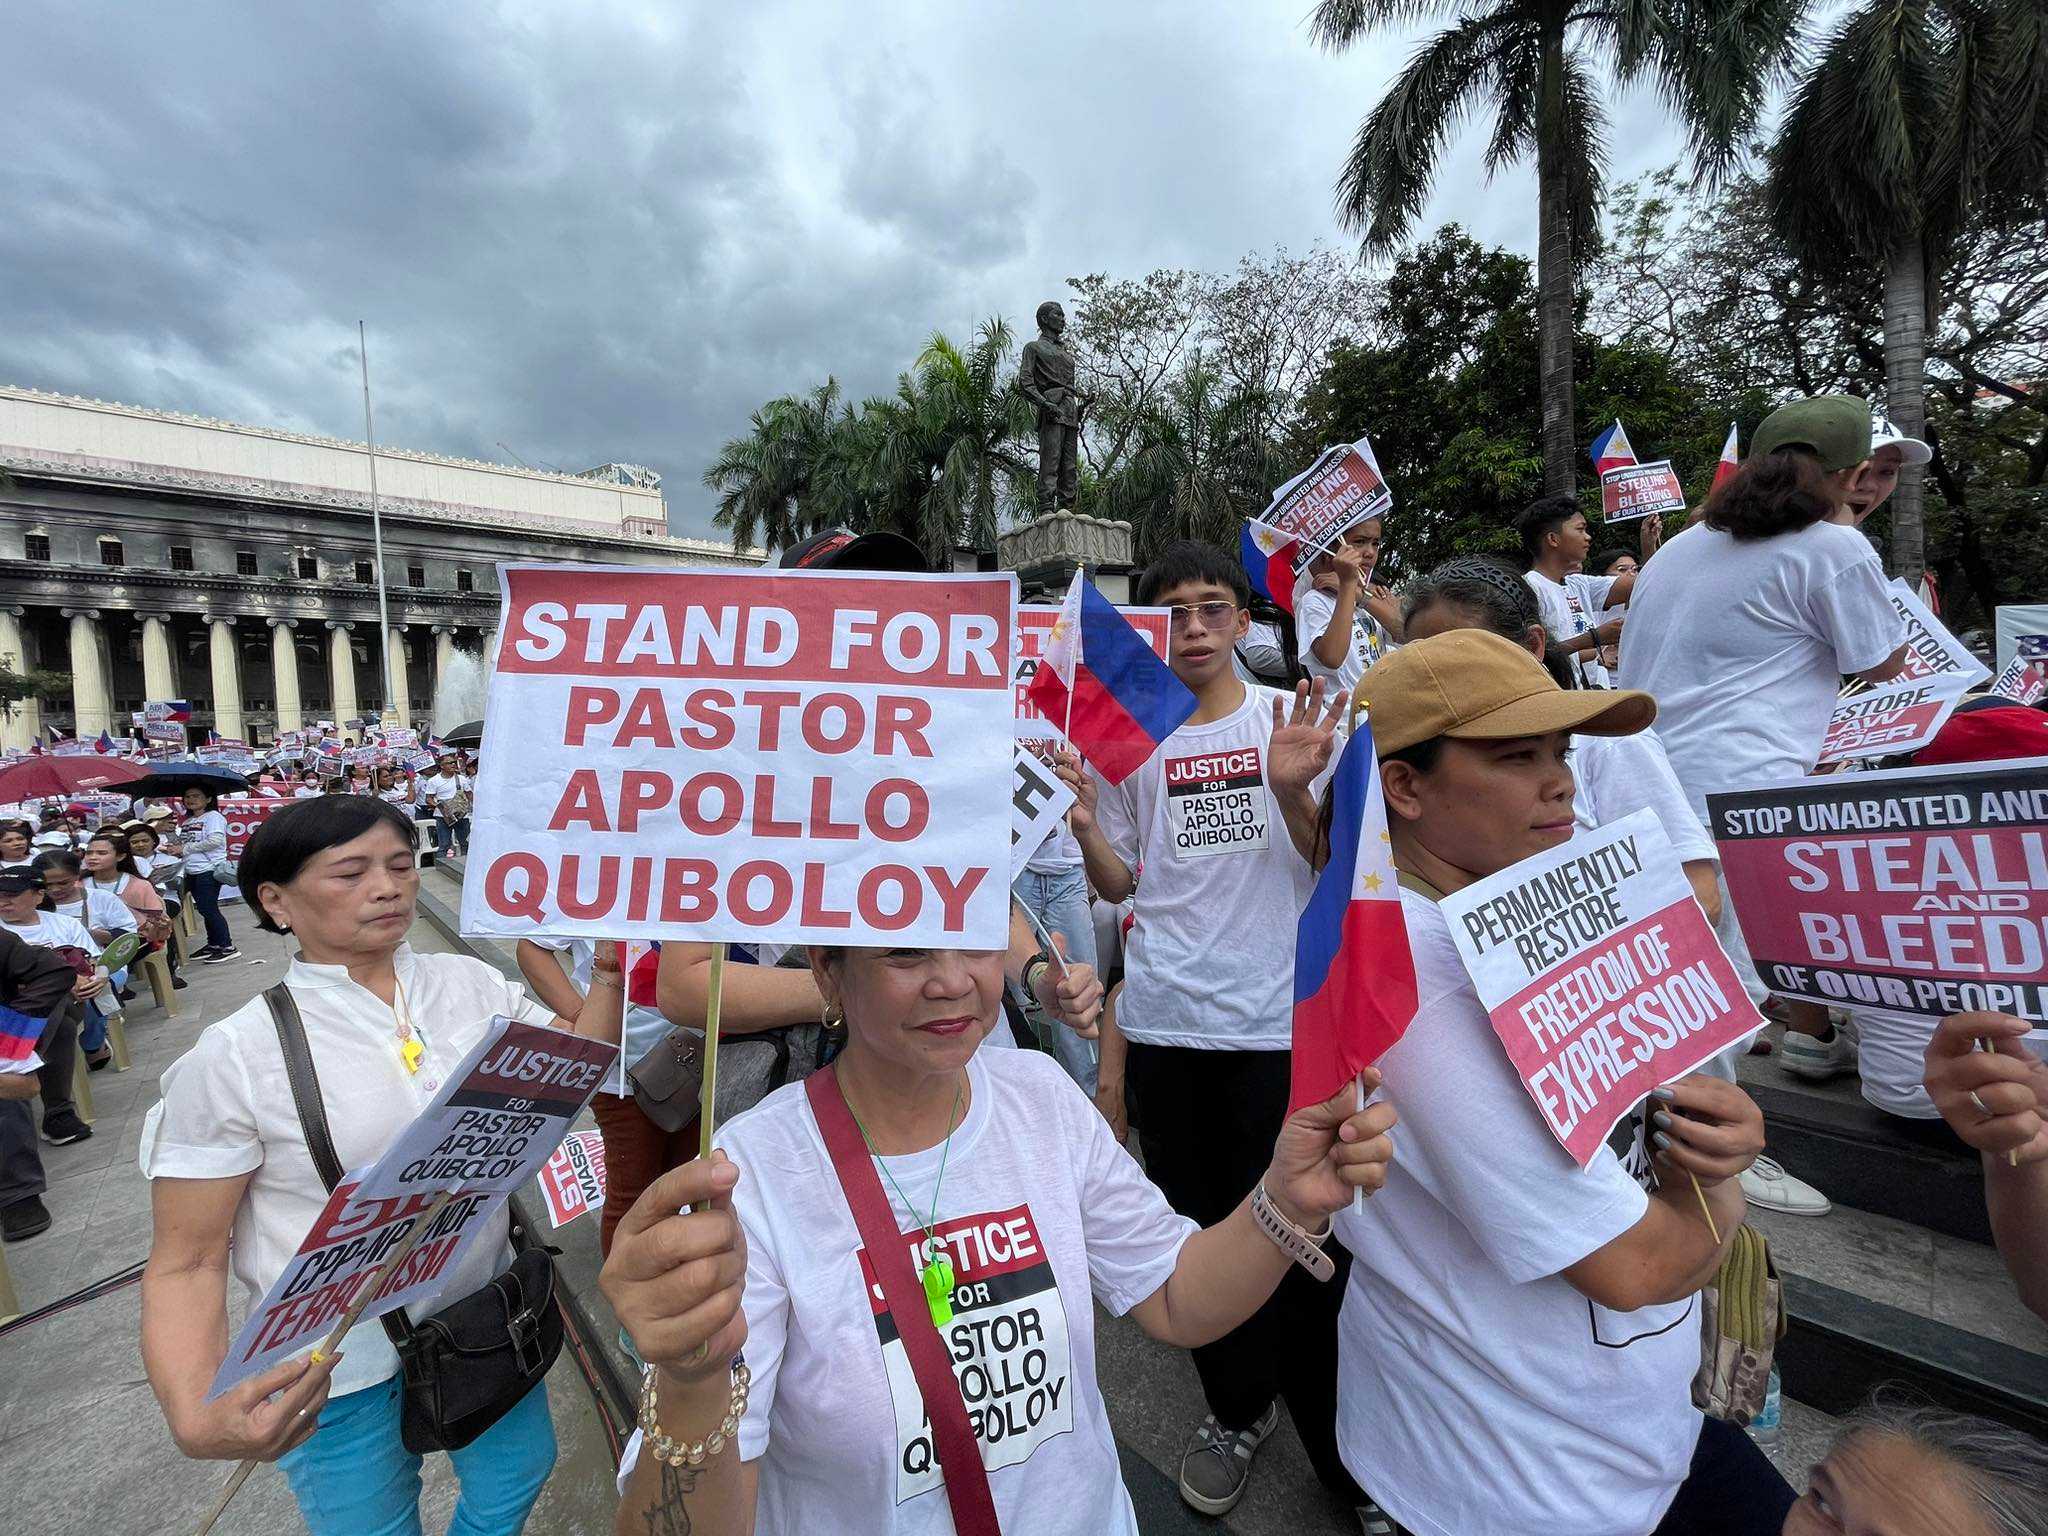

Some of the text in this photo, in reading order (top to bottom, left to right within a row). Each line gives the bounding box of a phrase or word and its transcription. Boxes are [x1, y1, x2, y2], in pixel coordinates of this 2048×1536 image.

[1280, 485, 1311, 515] UNABATED
[1309, 472, 1323, 490] AND
[1320, 448, 1350, 479] MASSIVE
[1282, 466, 1349, 532] STEALING
[1606, 475, 1621, 484] STOP
[1618, 475, 1667, 493] STEALING
[1619, 489, 1672, 508] BLEEDING
[1297, 551, 1306, 564] OF
[1317, 512, 1351, 544] PEOPLE'S
[1346, 490, 1377, 520] MONEY
[1299, 483, 1361, 540] LEEDING
[515, 601, 800, 668] STAND
[830, 608, 1003, 677] FOR
[563, 685, 934, 758] PASTOR
[1829, 709, 1905, 737] AW
[1830, 685, 1935, 724] ESTORE
[1169, 752, 1259, 782] JUSTICE
[1202, 779, 1227, 792] FOR
[547, 769, 930, 843] APOLLO
[1182, 792, 1252, 816] PASTOR
[1185, 809, 1254, 831] APOLLO
[1724, 789, 2048, 836] STOP UNABATED AND
[1177, 823, 1265, 848] QUIBOLOY
[485, 852, 989, 933] QUIBOLOY
[1461, 835, 1643, 956] PERMANENTLY
[1912, 894, 2030, 912] AND
[1514, 886, 1629, 977] RESTORE
[1798, 912, 2048, 974] BLEED
[1519, 923, 1671, 1054] FREEDOM OF
[1772, 965, 1810, 991] OF
[1814, 970, 1919, 1008] OUR
[479, 1045, 602, 1090] JUSTICE
[1528, 959, 1731, 1142] EXPRESSION
[451, 1110, 546, 1136] PASTOR
[431, 1135, 529, 1158] APOLLO
[399, 1158, 527, 1183] QUIBOLOY
[280, 1194, 490, 1301] CPP-NP-NDF
[941, 1308, 1044, 1366] STOR
